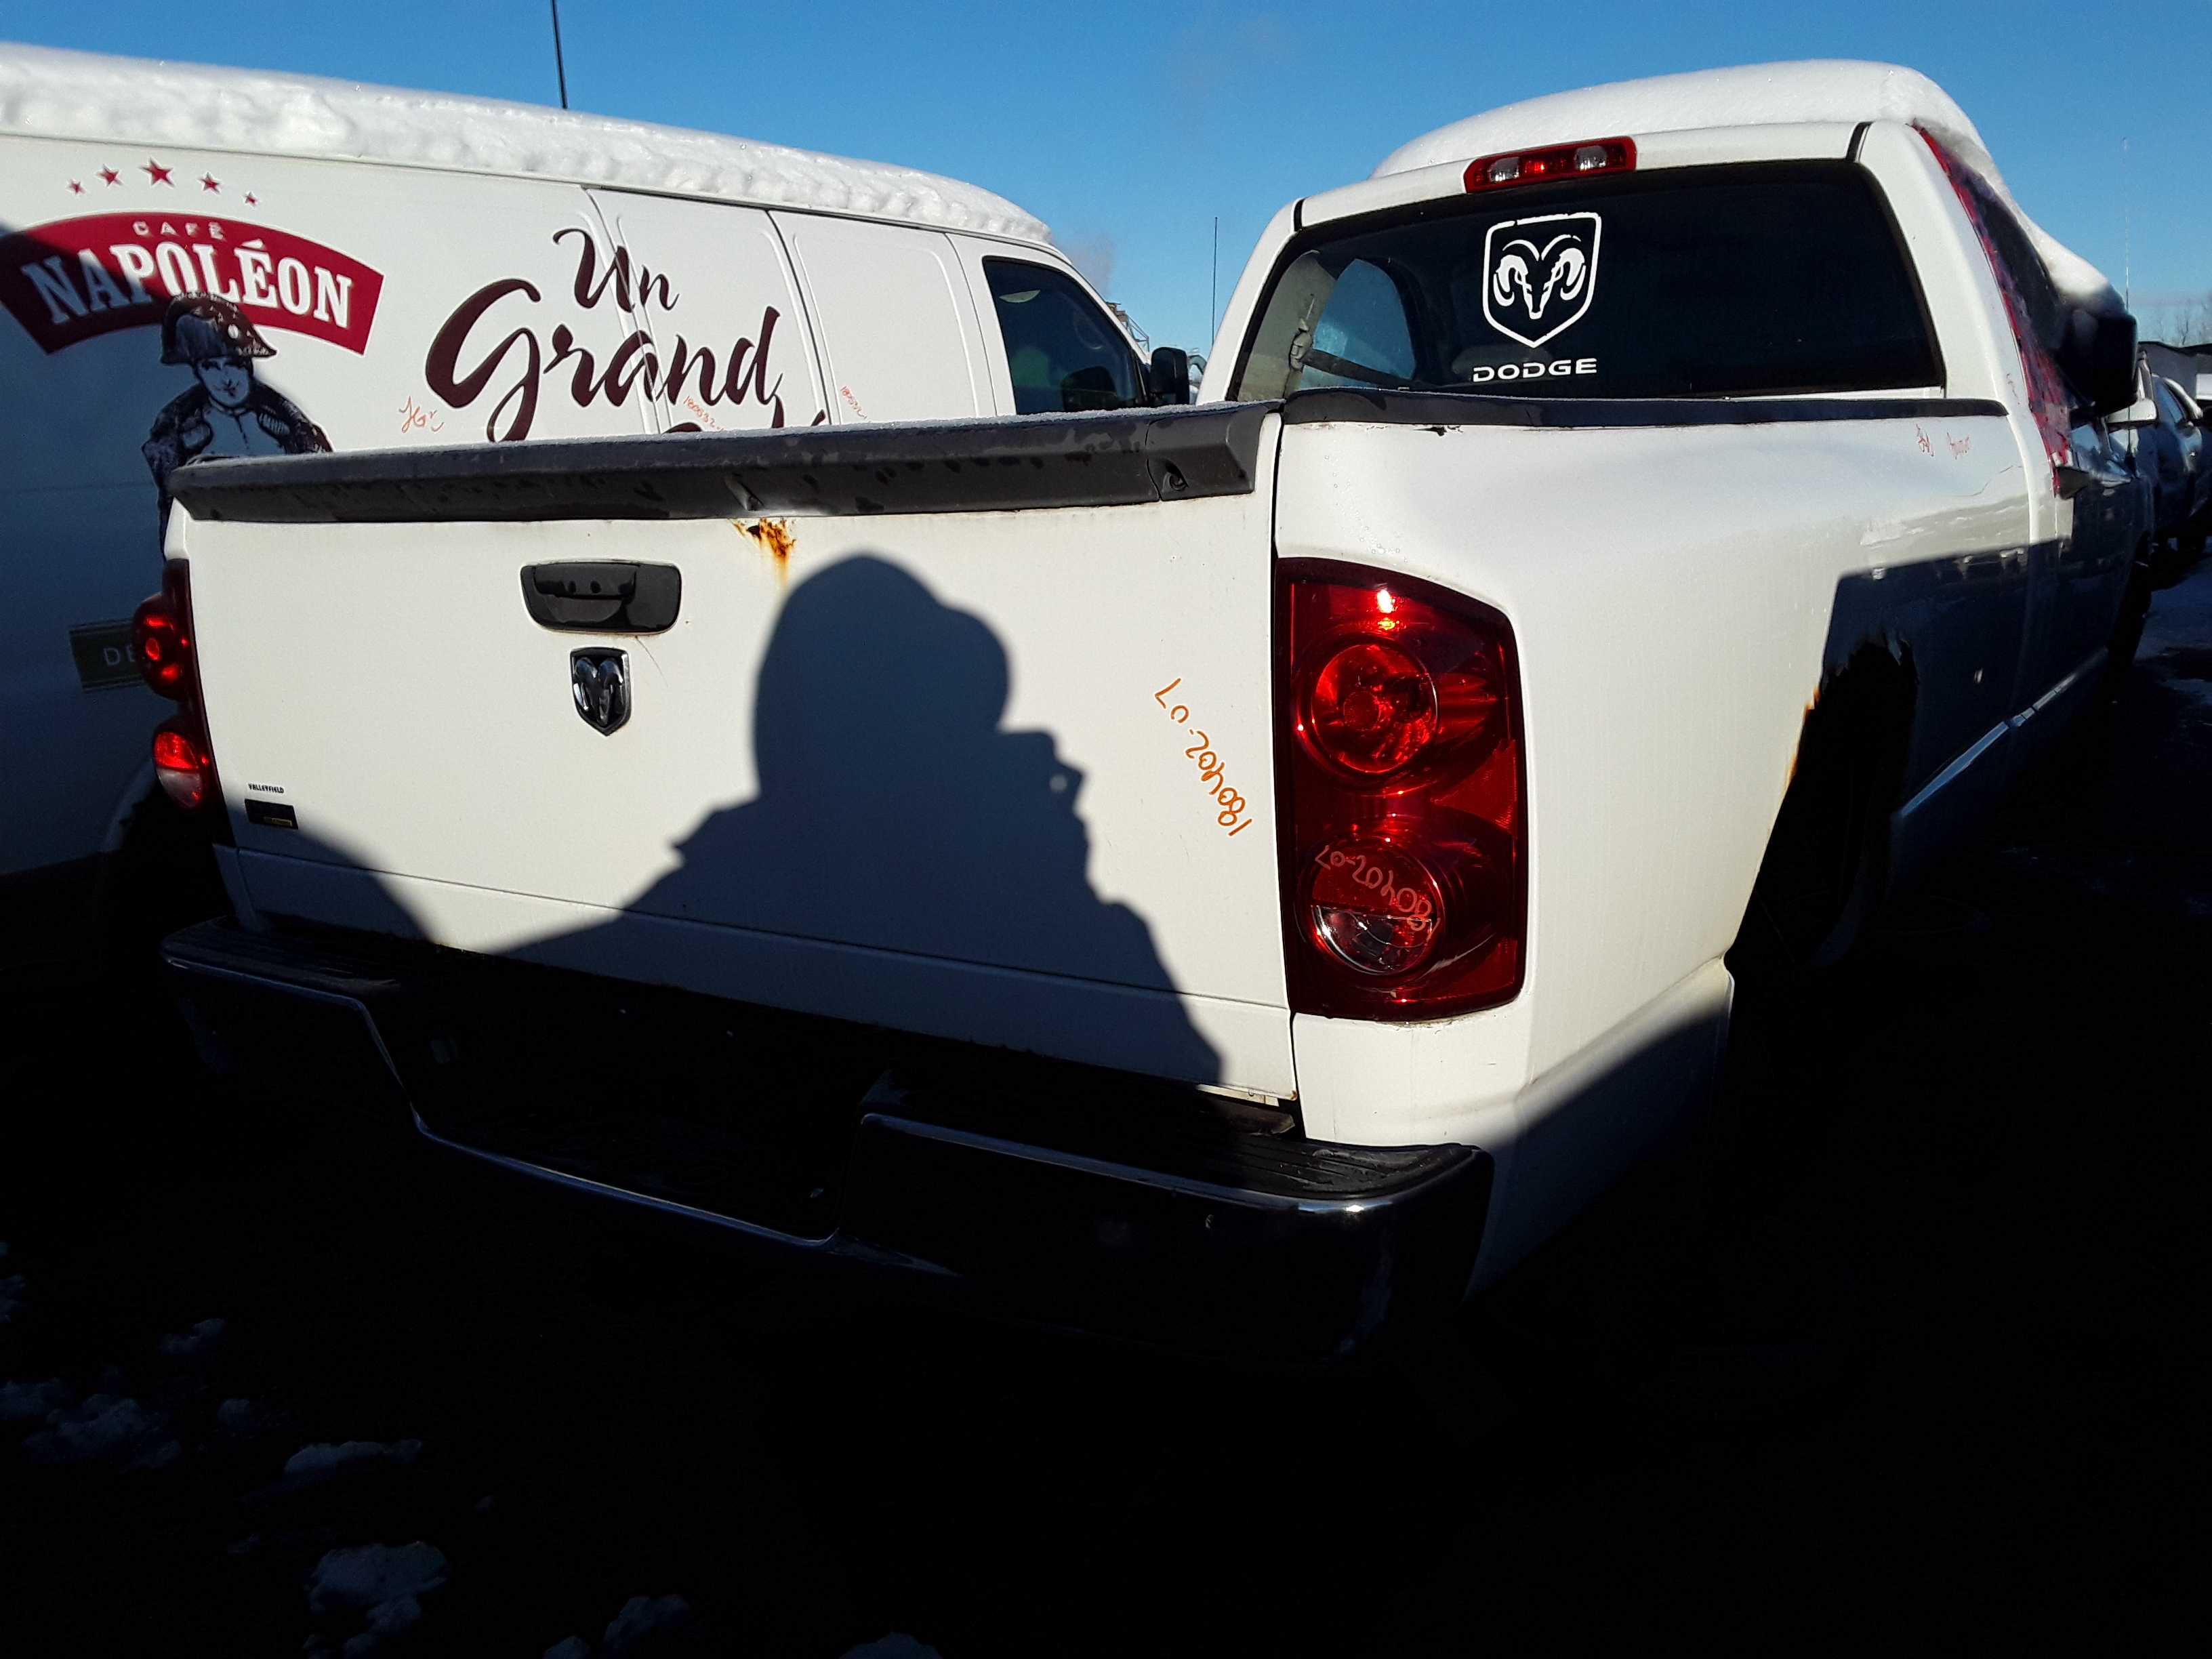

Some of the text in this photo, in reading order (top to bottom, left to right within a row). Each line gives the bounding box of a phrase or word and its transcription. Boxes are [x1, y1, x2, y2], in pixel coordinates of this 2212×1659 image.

[22, 239, 352, 327] NAPOLÉON
[552, 228, 679, 312] Un
[425, 279, 784, 443] Grand
[1473, 358, 1597, 382] DODGE
[248, 783, 285, 794] VALLEYFIELD
